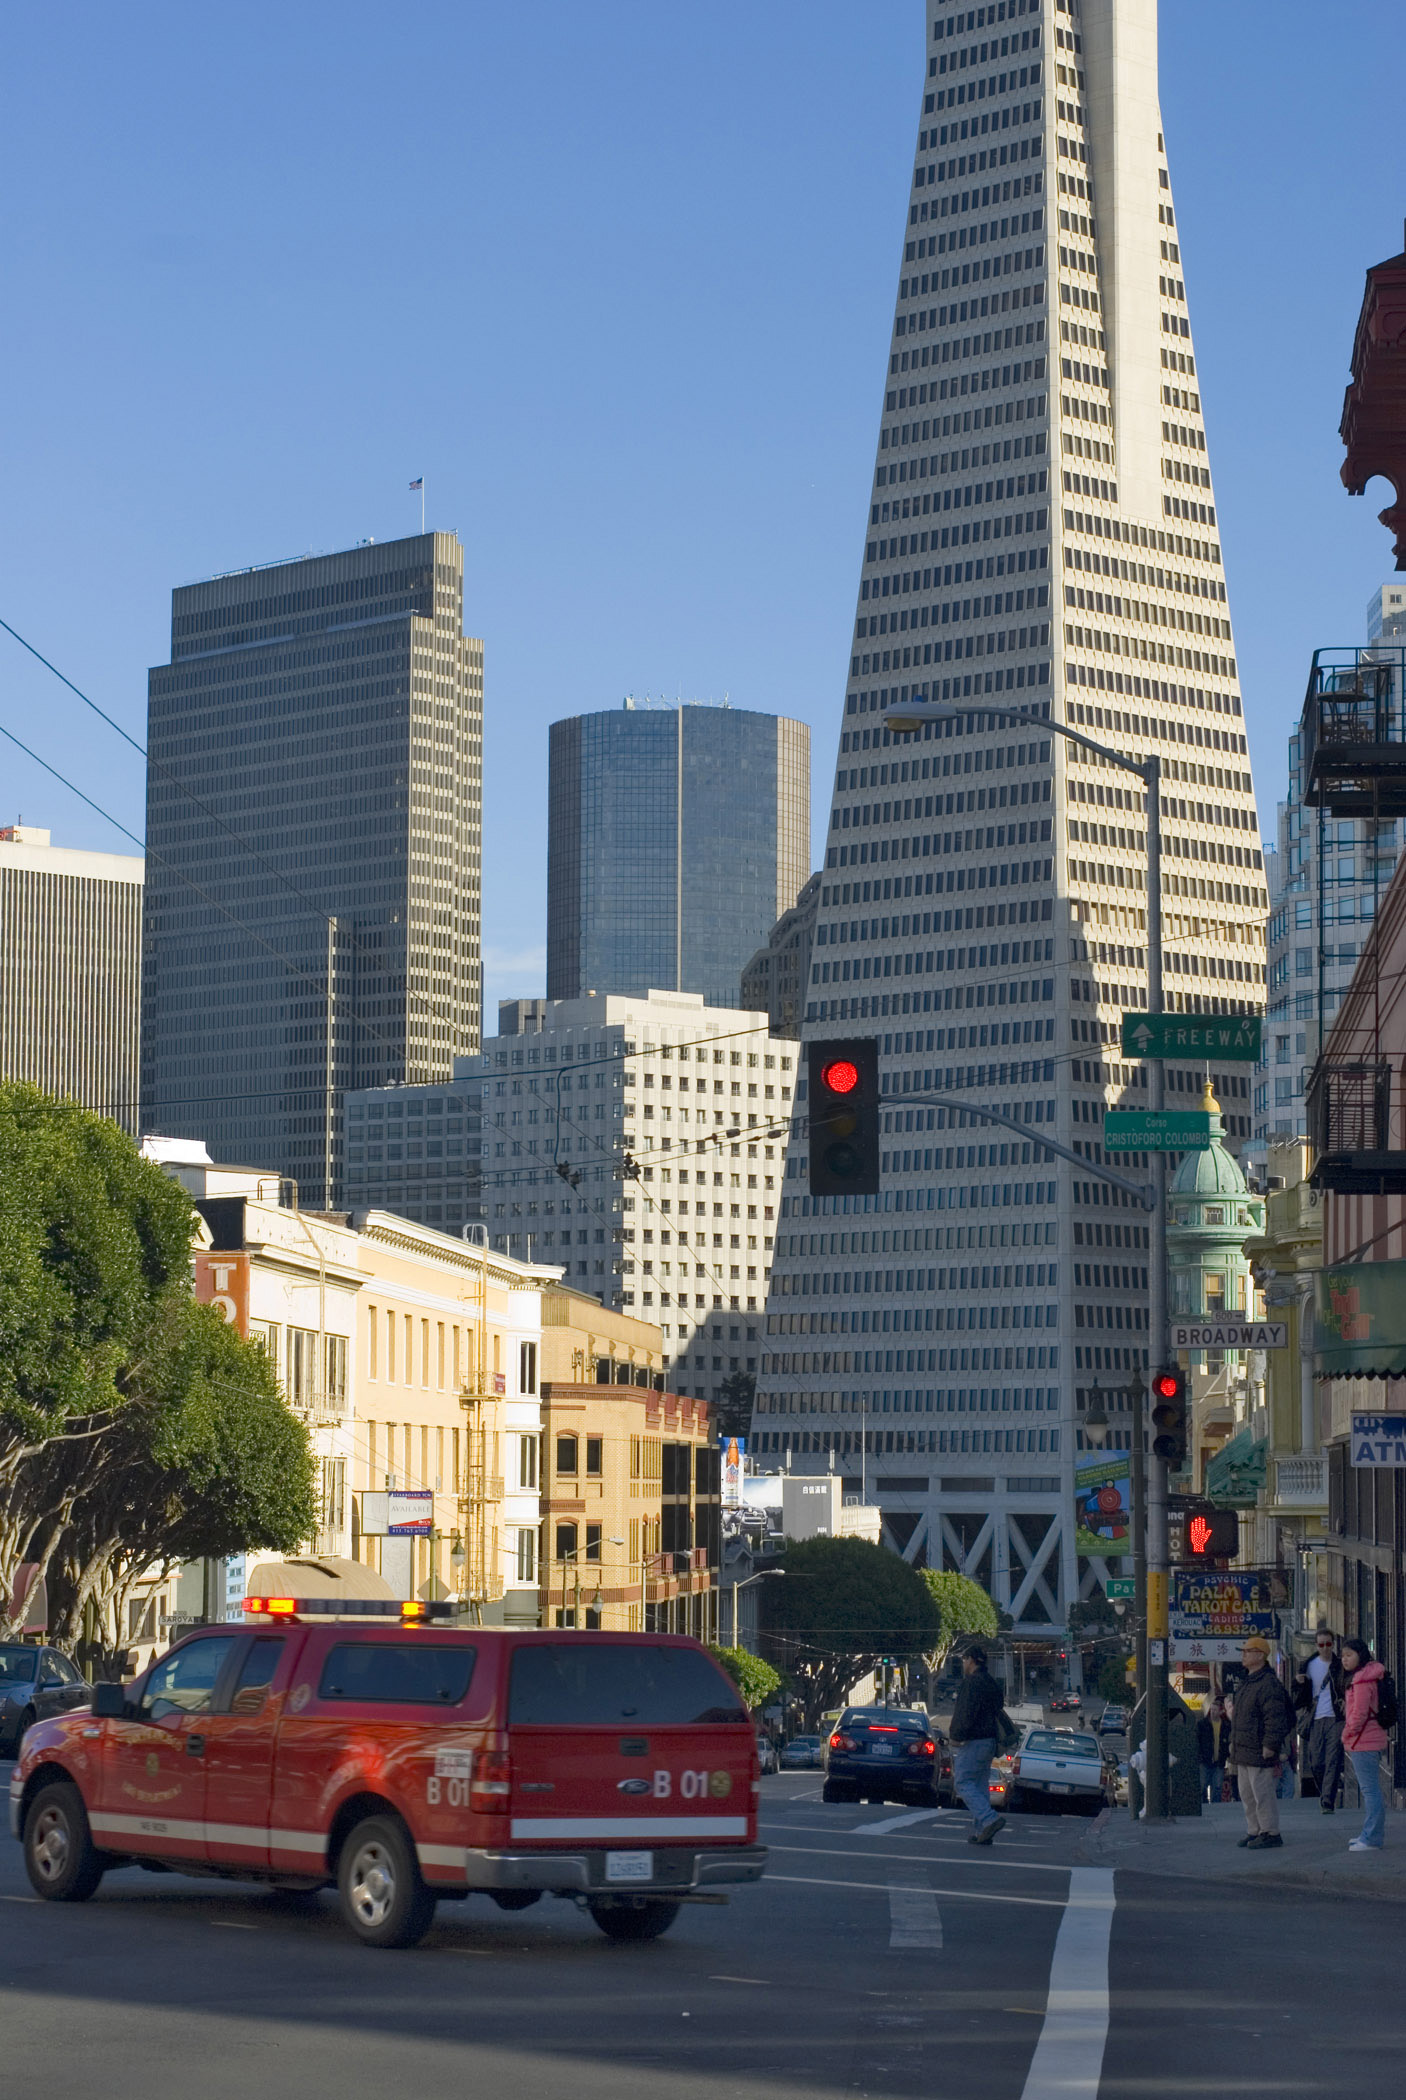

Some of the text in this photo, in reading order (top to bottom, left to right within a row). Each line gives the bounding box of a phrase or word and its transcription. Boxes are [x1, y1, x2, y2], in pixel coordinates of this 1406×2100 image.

[1164, 1028, 1256, 1047] FREEWAY
[1145, 1117, 1167, 1128] Corso
[1165, 1132, 1208, 1145] COLOMBO
[1215, 1312, 1232, 1320] 600
[1177, 1327, 1281, 1345] BROADWAY
[1190, 1586, 1239, 1599] PALM
[1182, 1600, 1230, 1613] TAROT
[1173, 1618, 1201, 1626] KEROUAC
[654, 1770, 671, 1797] B
[427, 1777, 440, 1804] B
